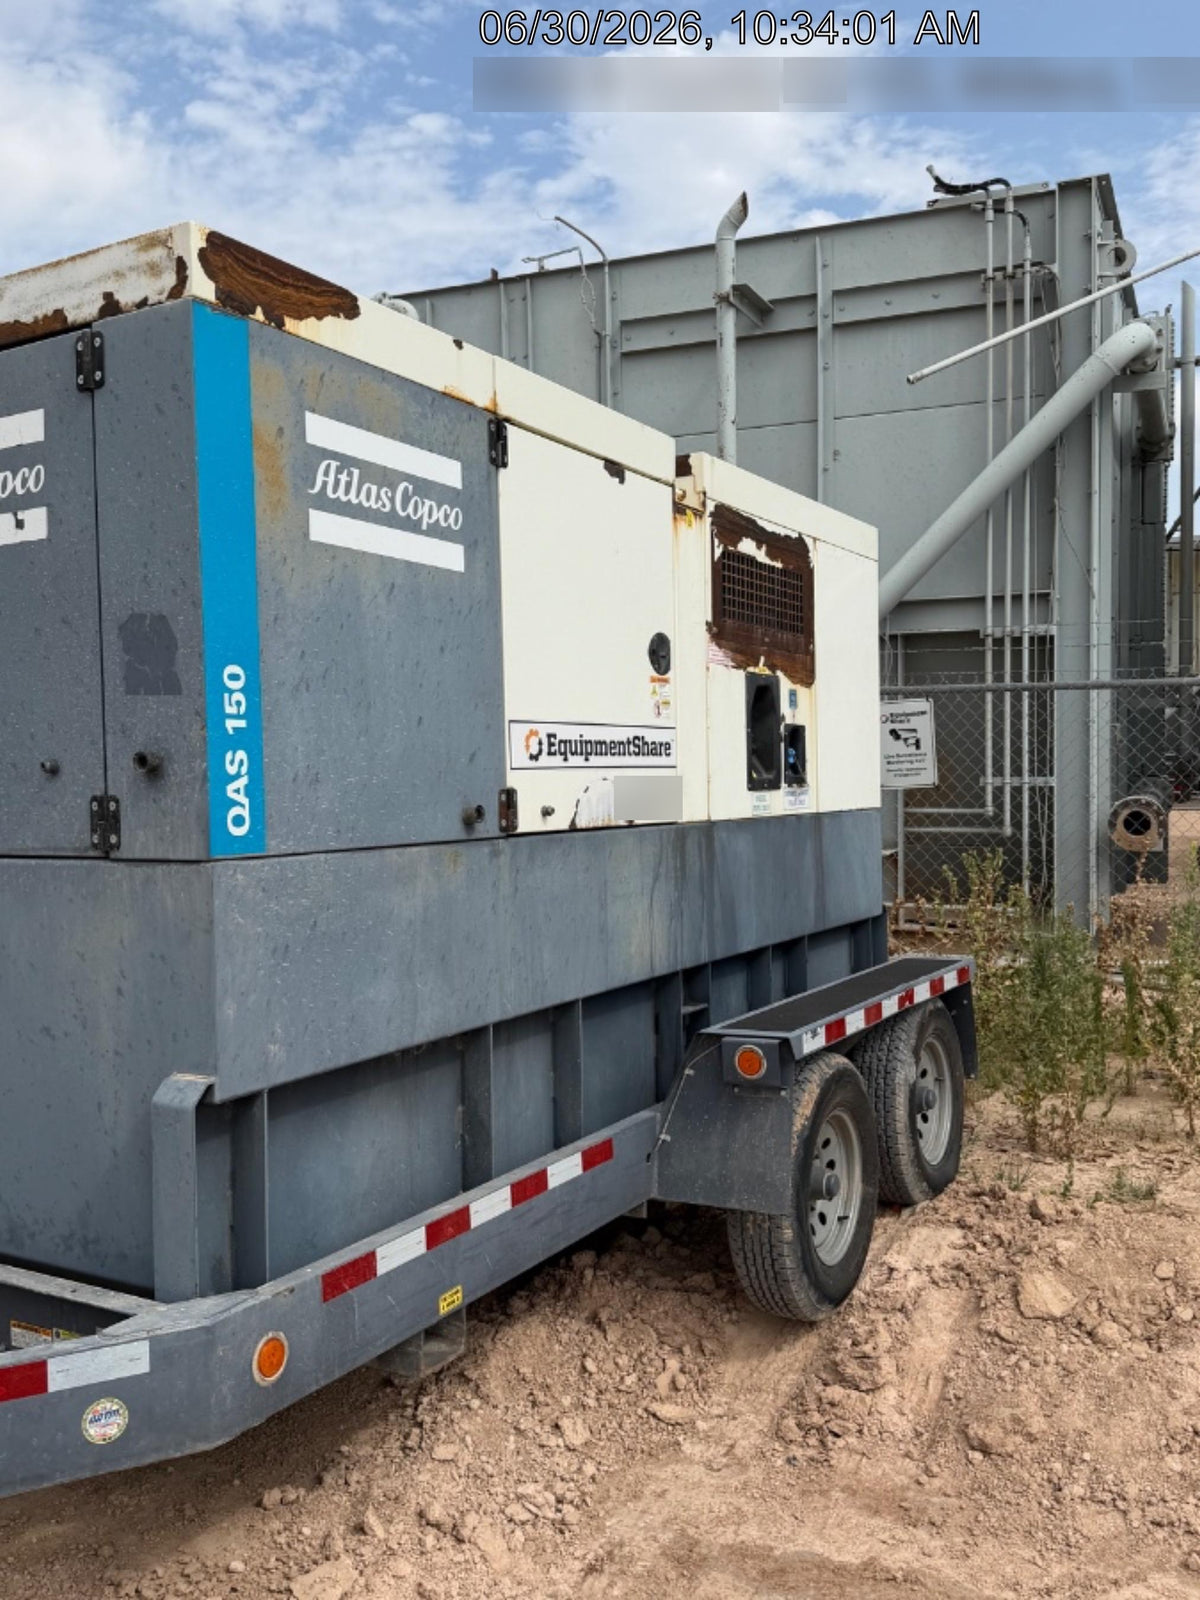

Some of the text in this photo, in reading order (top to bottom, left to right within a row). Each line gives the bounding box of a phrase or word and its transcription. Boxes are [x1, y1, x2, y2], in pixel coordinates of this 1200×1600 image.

[223, 664, 251, 837] QAS 150
[546, 732, 672, 762] EquipmentShare
